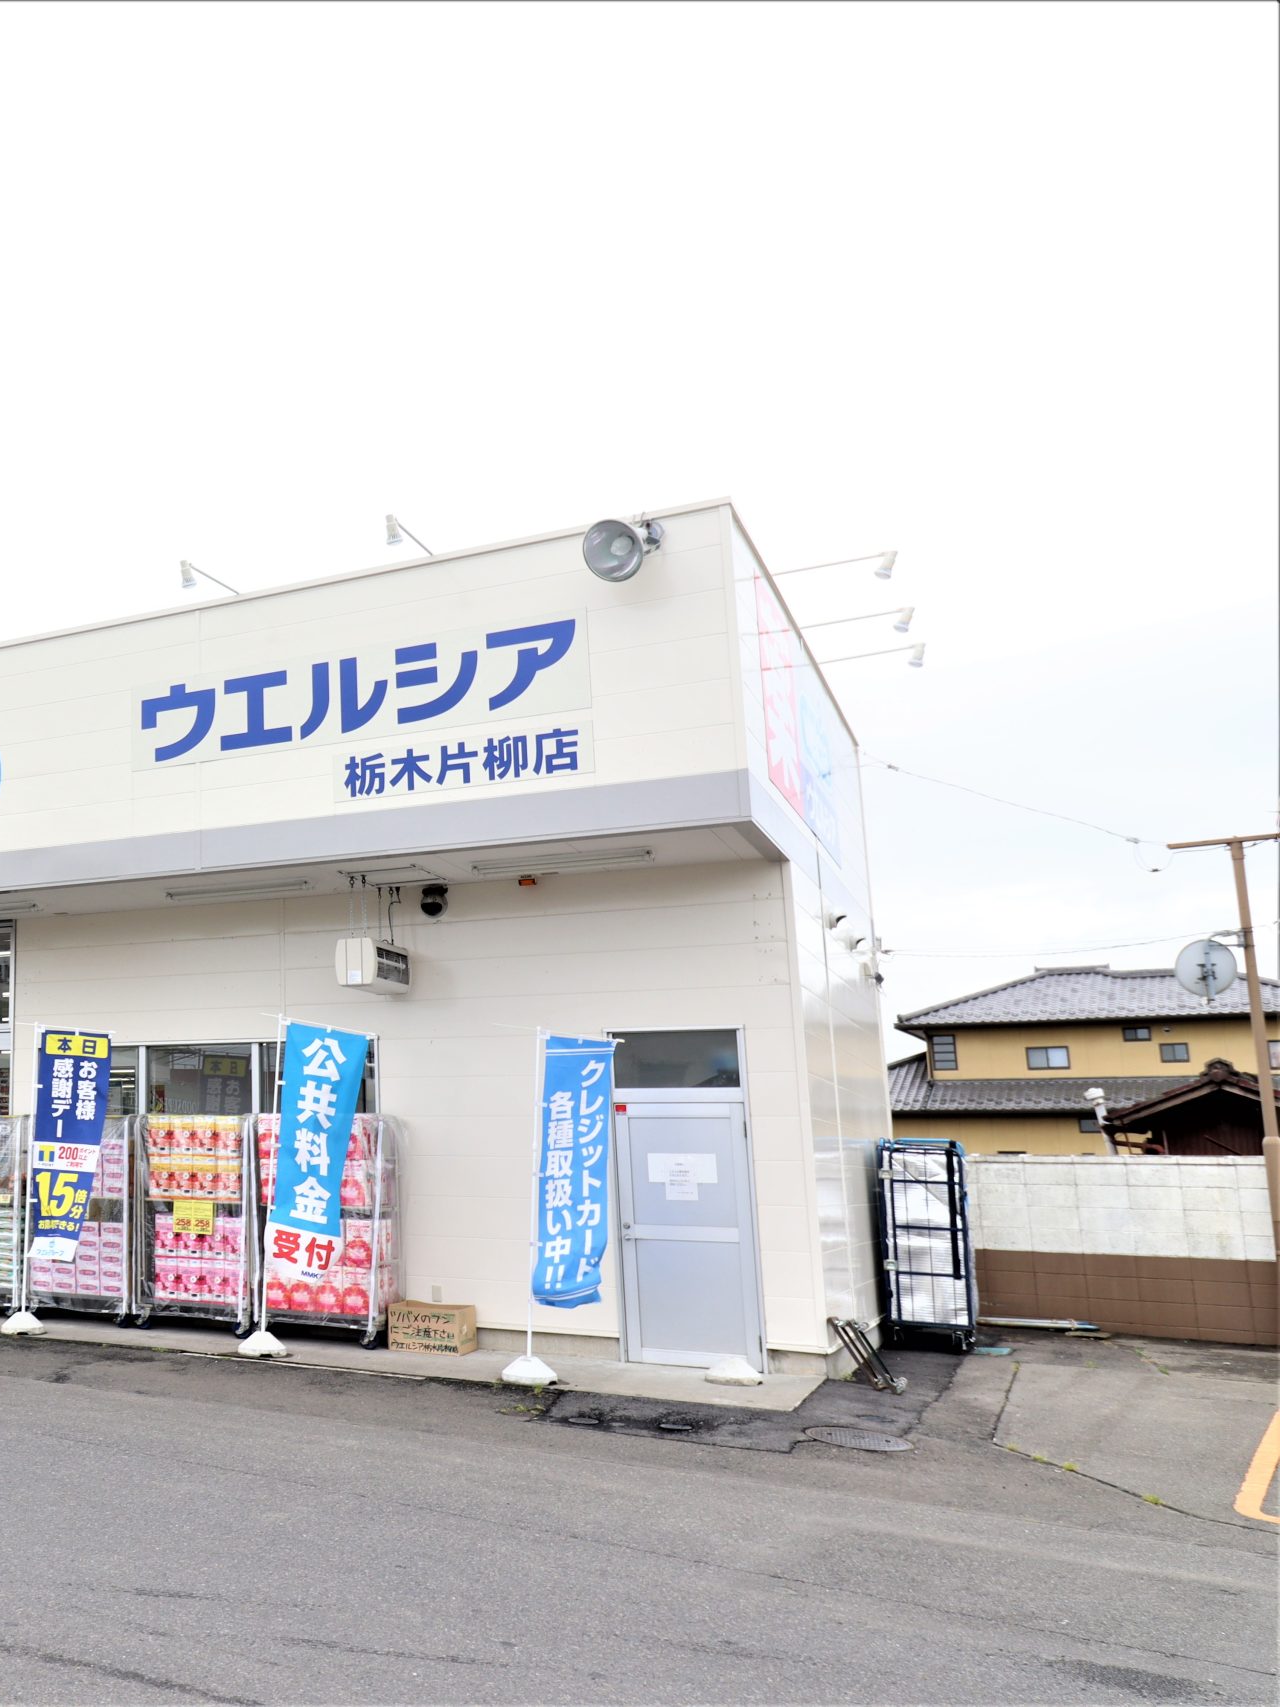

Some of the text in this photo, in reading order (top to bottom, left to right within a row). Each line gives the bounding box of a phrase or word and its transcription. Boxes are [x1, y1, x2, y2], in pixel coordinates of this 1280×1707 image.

[141, 618, 576, 762] ウエルシア
[344, 728, 579, 798] 栃木片柳店
[57, 1037, 97, 1054] 本日
[51, 1058, 74, 1138] 感謝デー
[76, 1059, 99, 1120] お客様
[58, 1146, 79, 1160] 200
[289, 1037, 347, 1225] 公共料金
[576, 1060, 606, 1282] クレジットカード
[272, 1228, 336, 1271] 受付
[301, 1270, 324, 1279] MMK
[390, 1310, 457, 1325] ツバメのフン
[390, 1325, 456, 1340] にご注意下さい
